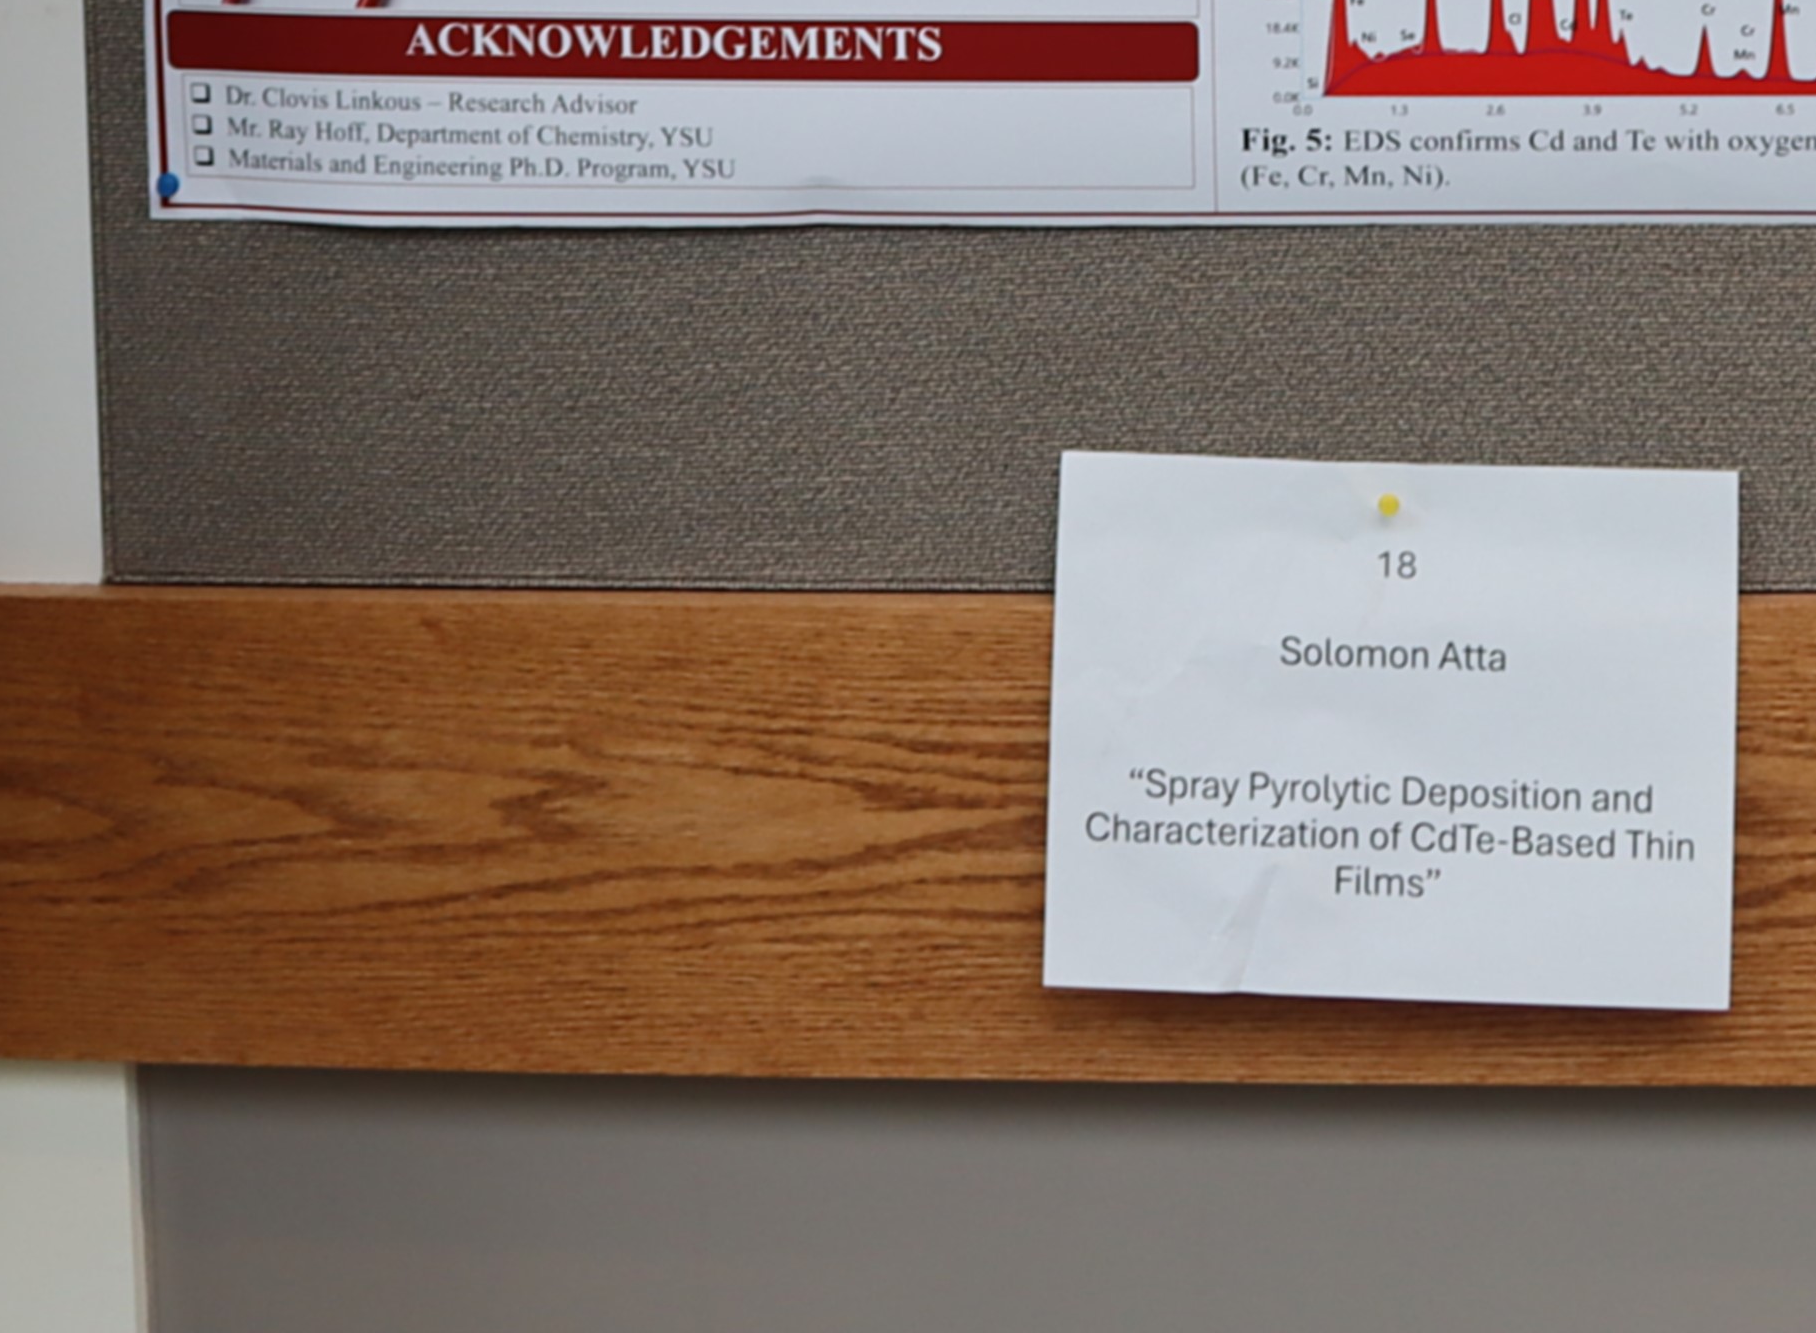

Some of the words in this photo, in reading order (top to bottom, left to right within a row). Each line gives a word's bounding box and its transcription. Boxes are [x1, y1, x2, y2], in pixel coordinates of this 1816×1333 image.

[407, 22, 943, 63] ACKNOWLEDGEMENTS
[226, 85, 257, 108] Dr.
[262, 86, 331, 111] Clovis
[336, 89, 423, 114] Linkous
[449, 91, 547, 116] Research
[552, 93, 640, 117] Advisor
[1241, 165, 1291, 191] (Fe,
[1298, 165, 1336, 190] Cr,
[1345, 165, 1395, 189] Mn,
[1404, 165, 1451, 190] Ni).
[1379, 550, 1418, 582] 18
[1281, 635, 1431, 672] Solomon
[1438, 641, 1508, 675] Atta
[1249, 770, 1392, 813] Pyrolytic
[1402, 775, 1583, 816] Deposition
[1592, 784, 1654, 816] and
[1086, 811, 1361, 851] Characterization
[1370, 821, 1403, 853] of
[1411, 821, 1617, 861] CdTe-Based
[1626, 829, 1696, 863] Thin
